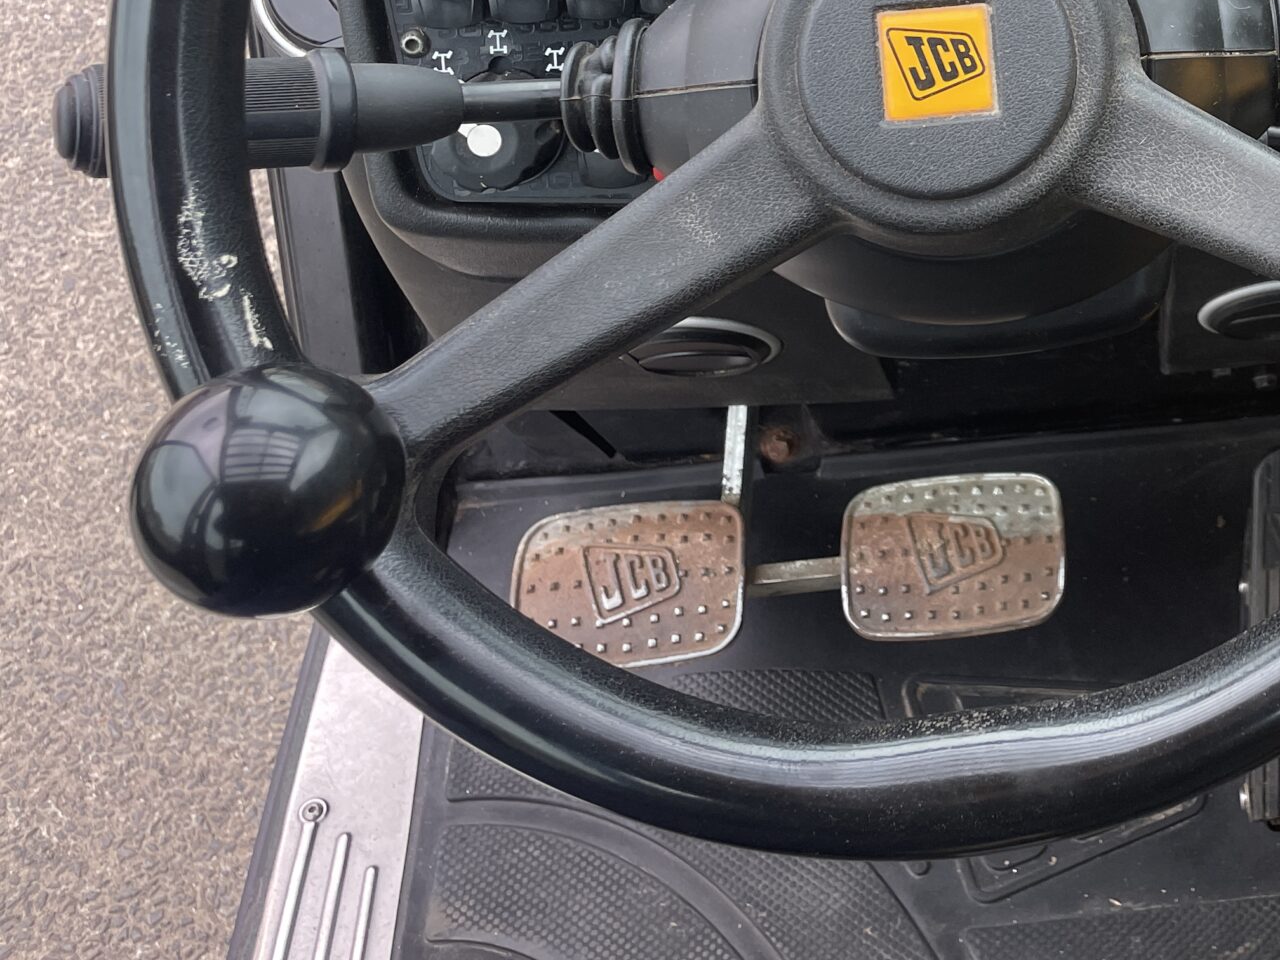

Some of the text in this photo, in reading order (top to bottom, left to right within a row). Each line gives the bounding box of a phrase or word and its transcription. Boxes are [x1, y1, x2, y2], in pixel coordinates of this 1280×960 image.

[905, 36, 978, 91] JCB
[928, 522, 997, 579] JCB
[600, 552, 671, 611] JCB
